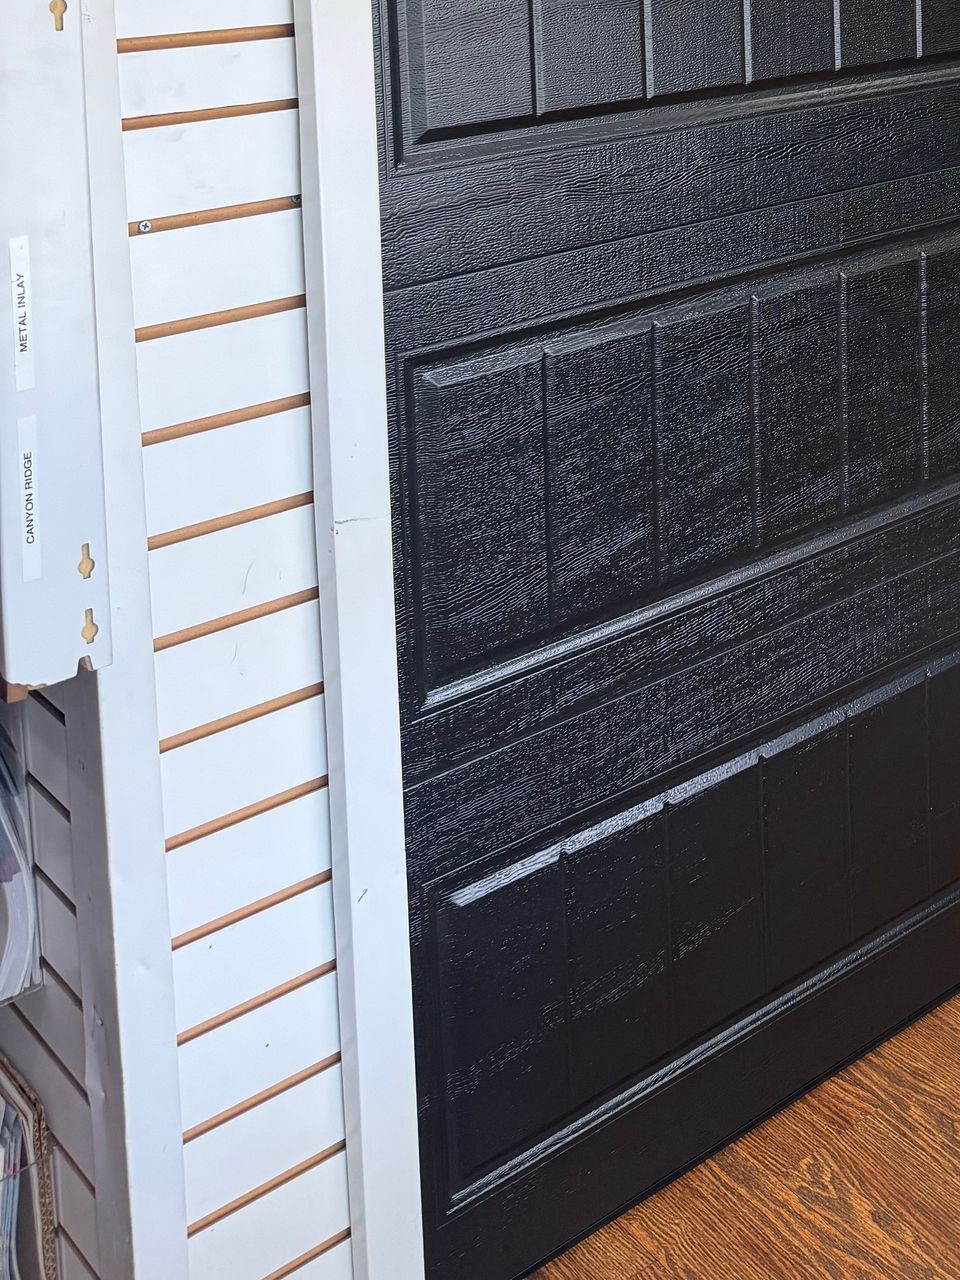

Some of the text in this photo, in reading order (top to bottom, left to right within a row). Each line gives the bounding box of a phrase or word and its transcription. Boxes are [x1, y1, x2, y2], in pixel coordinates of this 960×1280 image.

[16, 273, 28, 352] METAL INLAY
[23, 451, 35, 544] CANYON RIDGE
